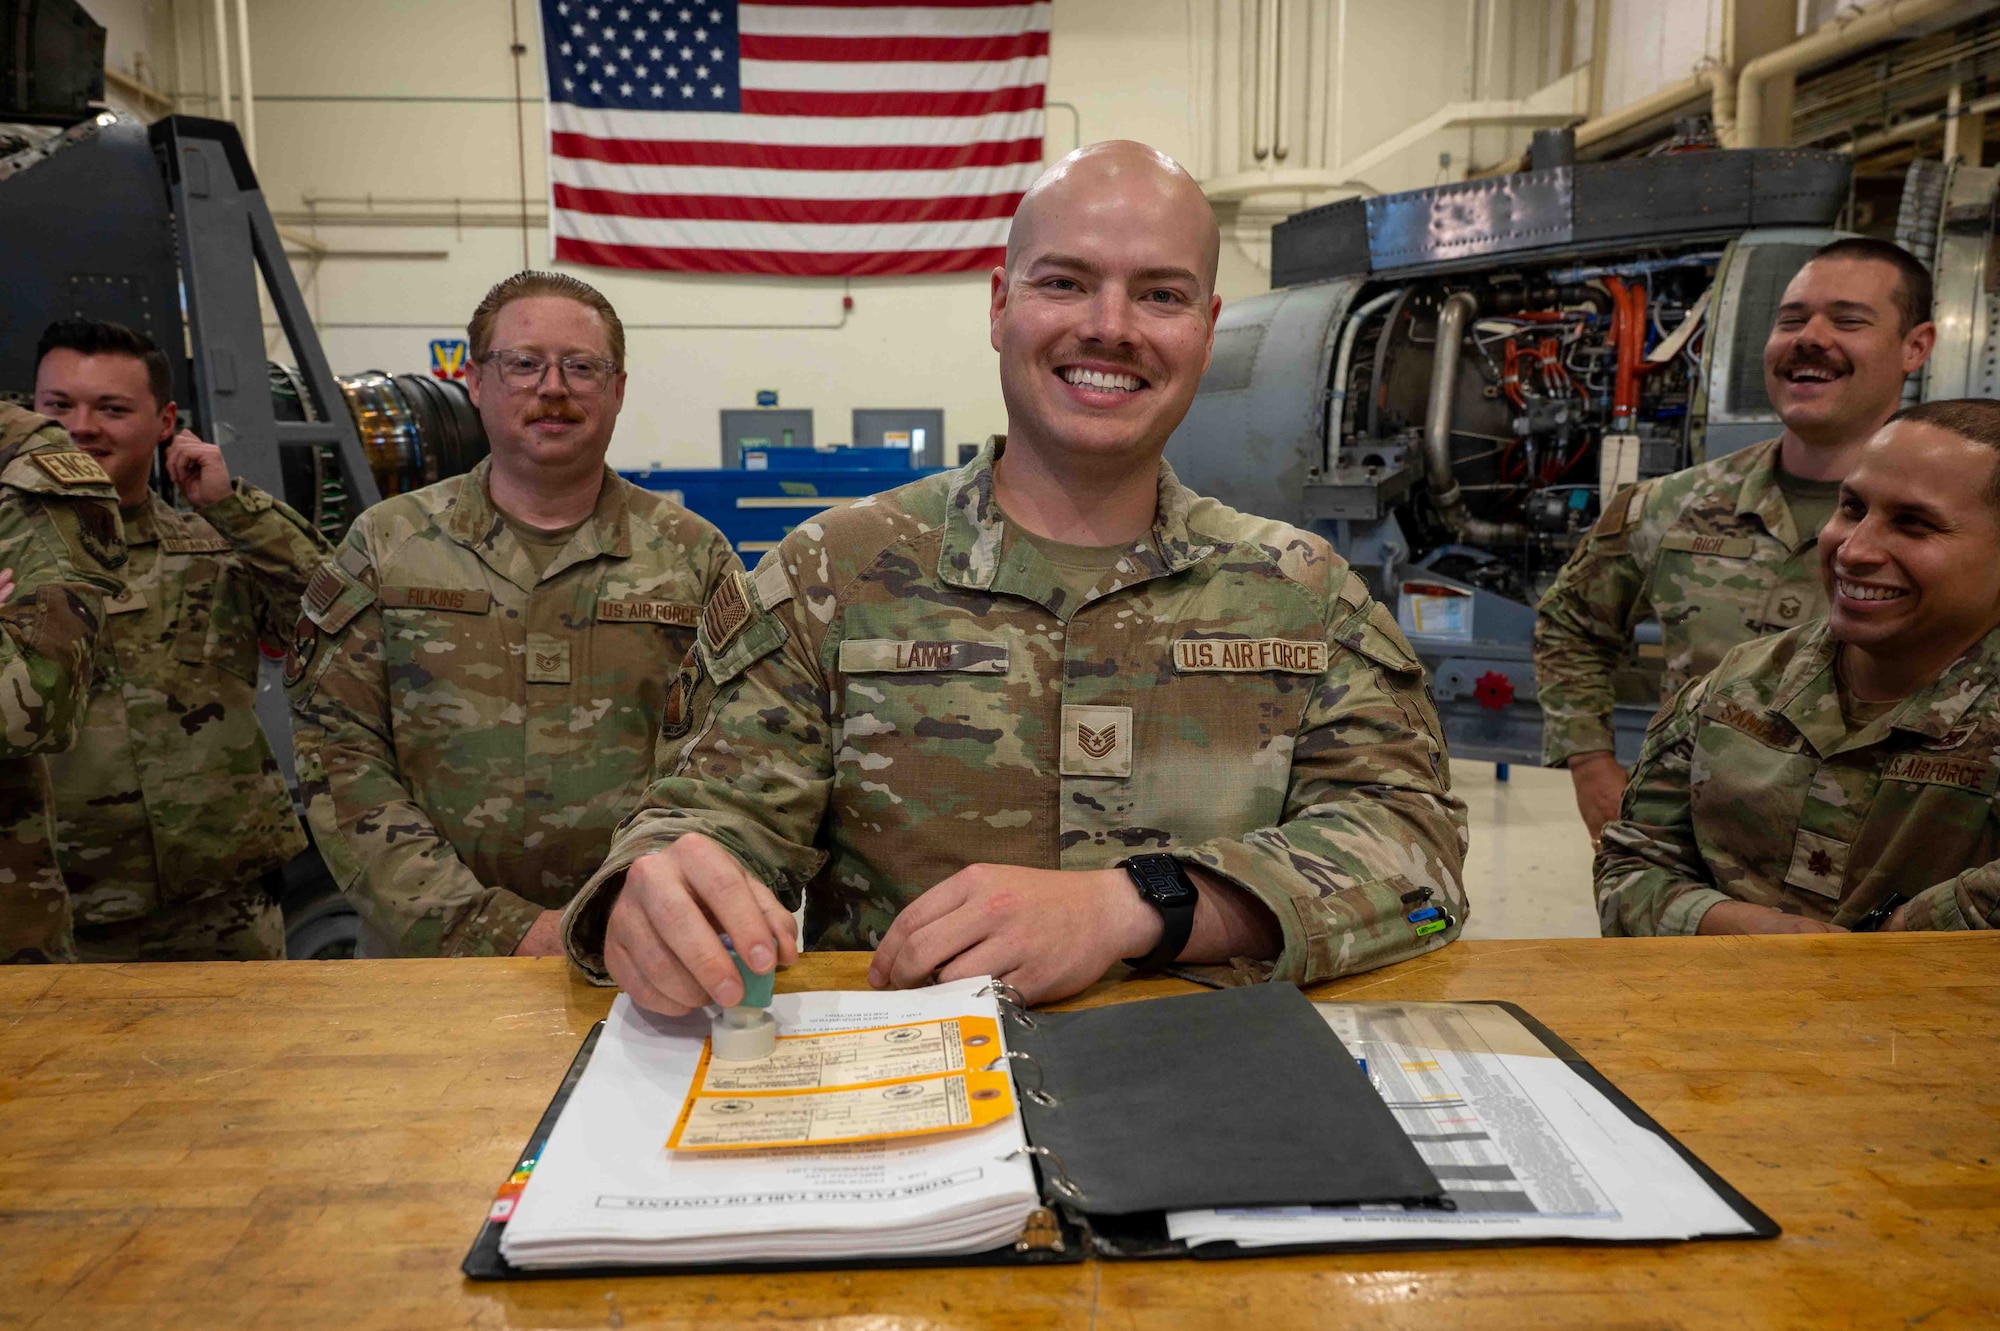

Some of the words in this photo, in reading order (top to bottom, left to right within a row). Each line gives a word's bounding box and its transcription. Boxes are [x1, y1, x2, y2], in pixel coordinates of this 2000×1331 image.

[44, 452, 105, 478] ENGS
[1692, 536, 1725, 552] RICH
[407, 587, 465, 609] FILKINS
[629, 603, 653, 619] AIR
[656, 605, 697, 623] FORCE
[896, 643, 952, 670] LAMB
[1183, 643, 1217, 668] U.S.
[1222, 643, 1255, 668] AIR
[1259, 641, 1320, 670] FORCE
[1902, 759, 1930, 779] AIR
[1929, 762, 1987, 789] FORCE
